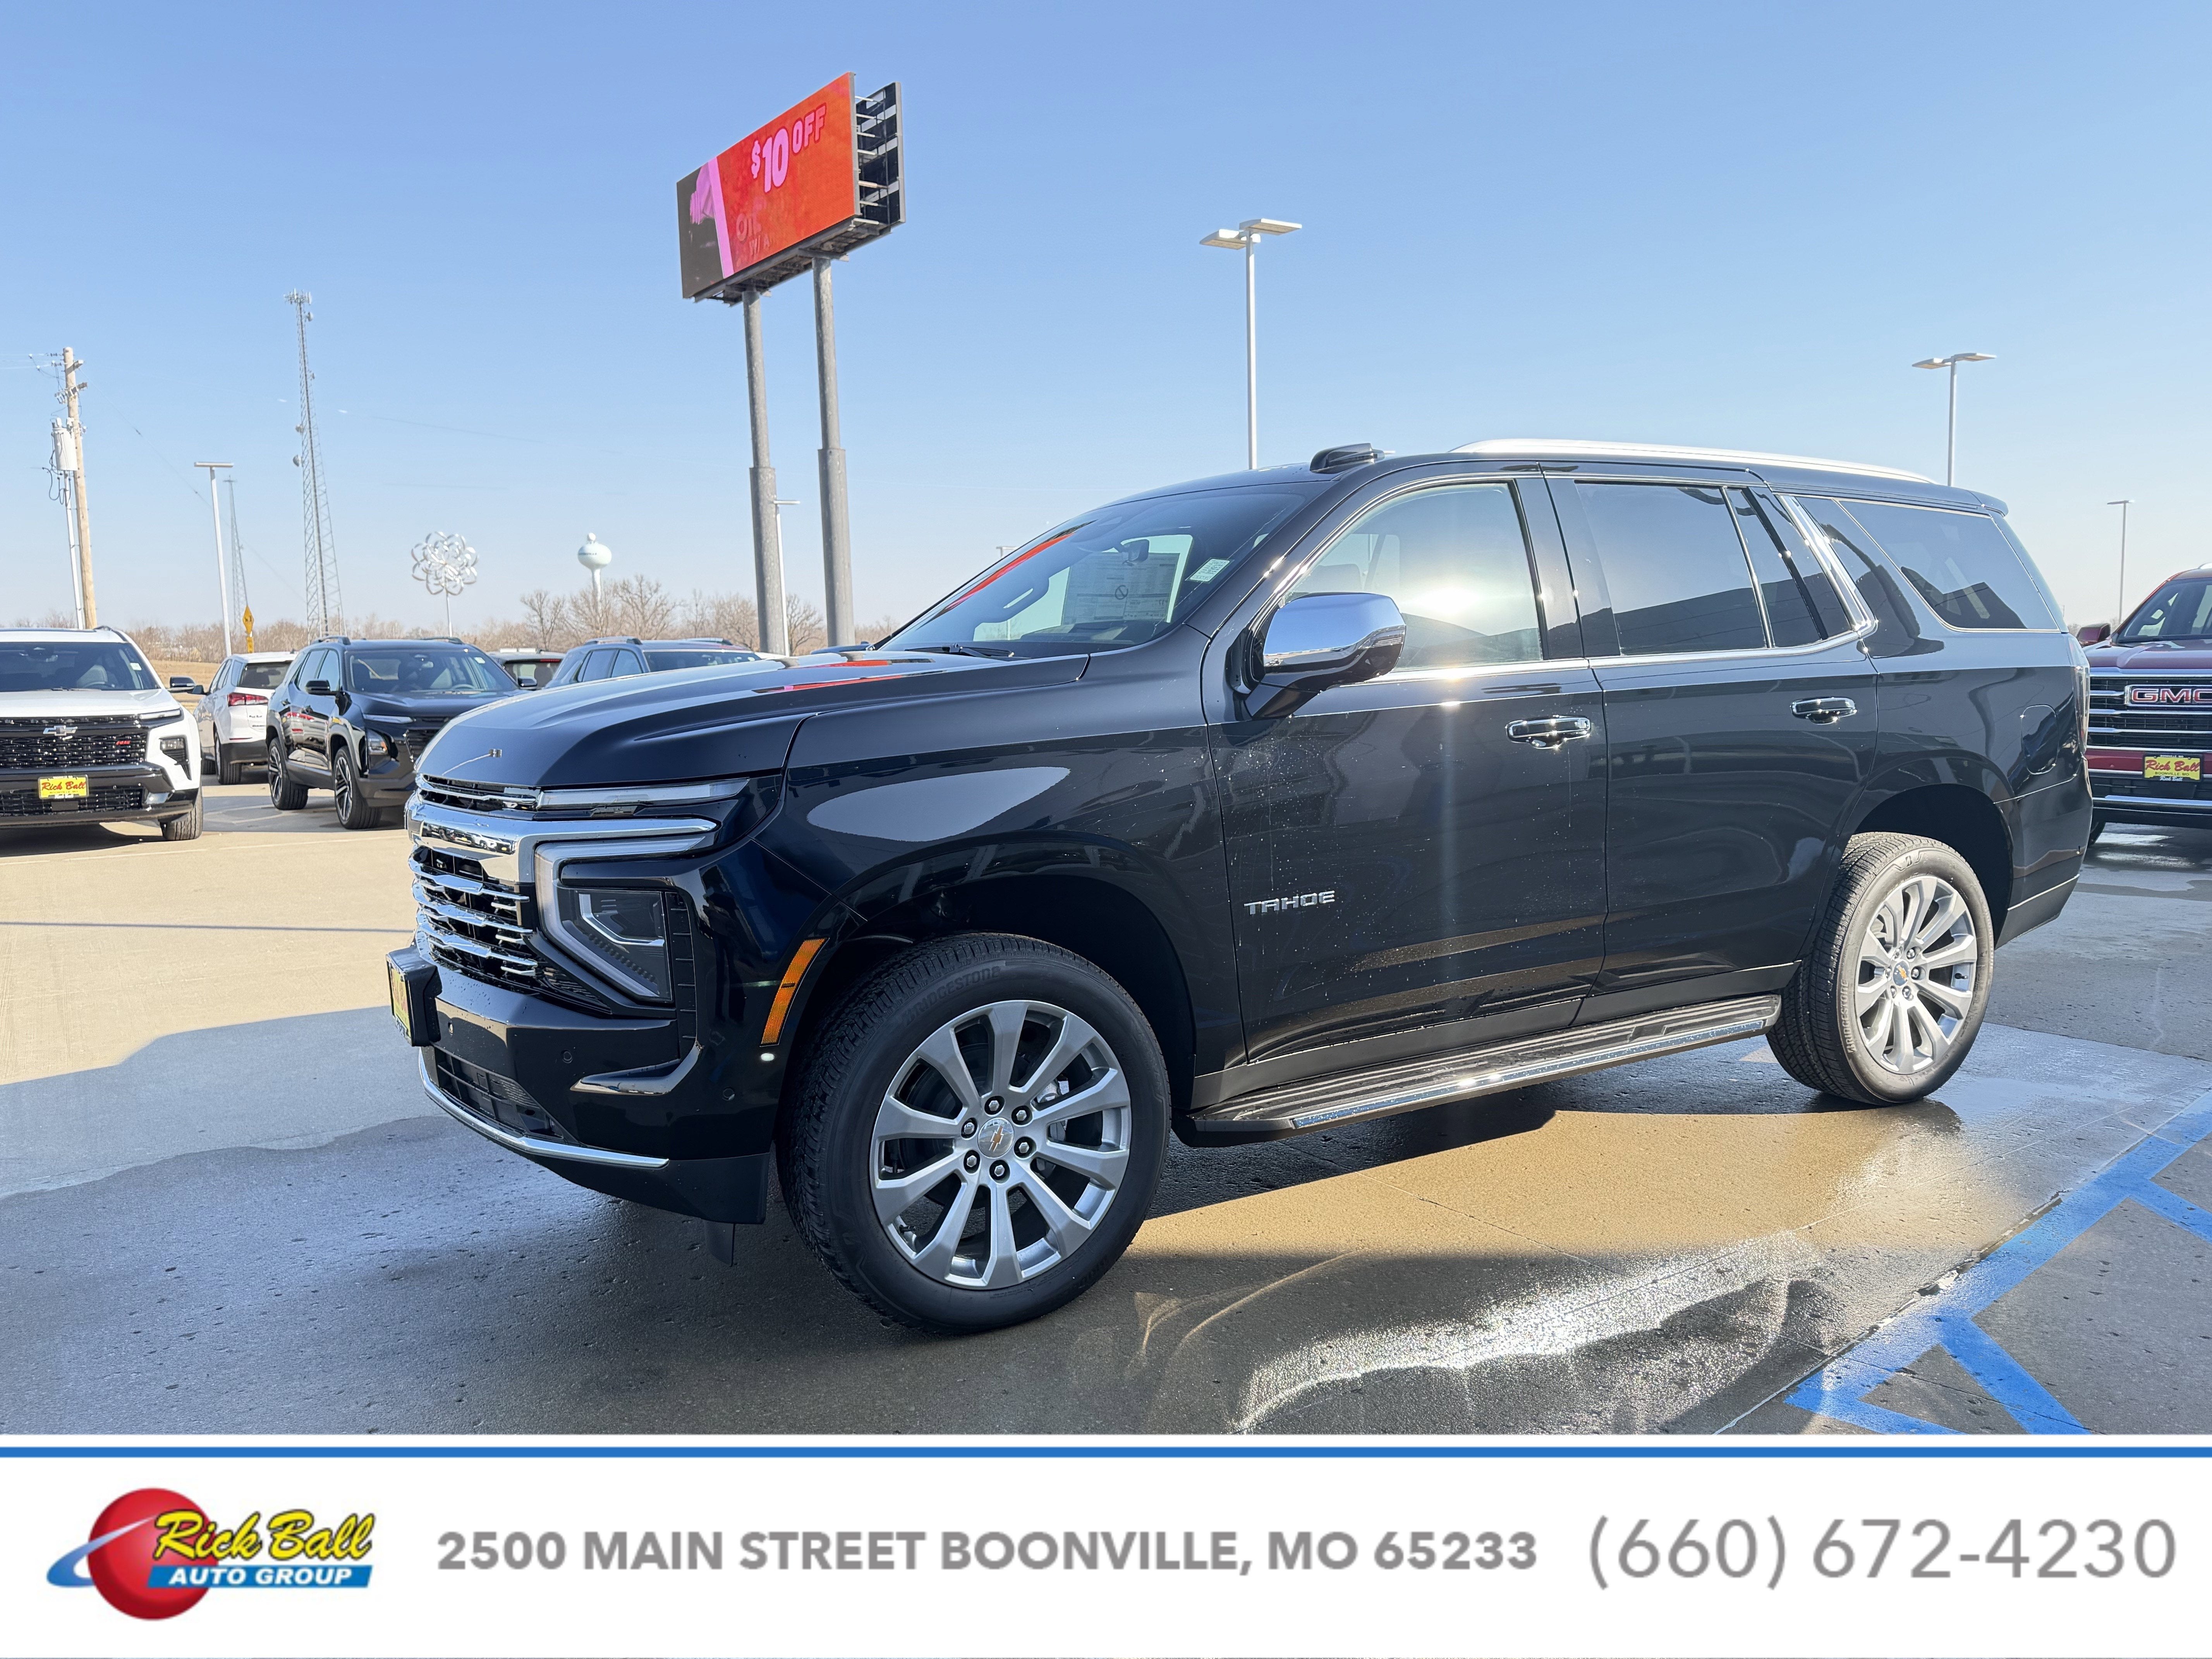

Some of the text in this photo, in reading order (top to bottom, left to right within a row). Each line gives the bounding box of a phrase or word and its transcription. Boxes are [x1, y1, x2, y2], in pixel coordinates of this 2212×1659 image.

[751, 104, 826, 193] $10 OFF
[2131, 688, 2212, 703] GMC
[2146, 759, 2200, 772] Rick Ball
[41, 781, 86, 791] Rick Ball
[1243, 890, 1335, 915] TAHOE
[1840, 979, 1857, 1053] BRIDGESTONE
